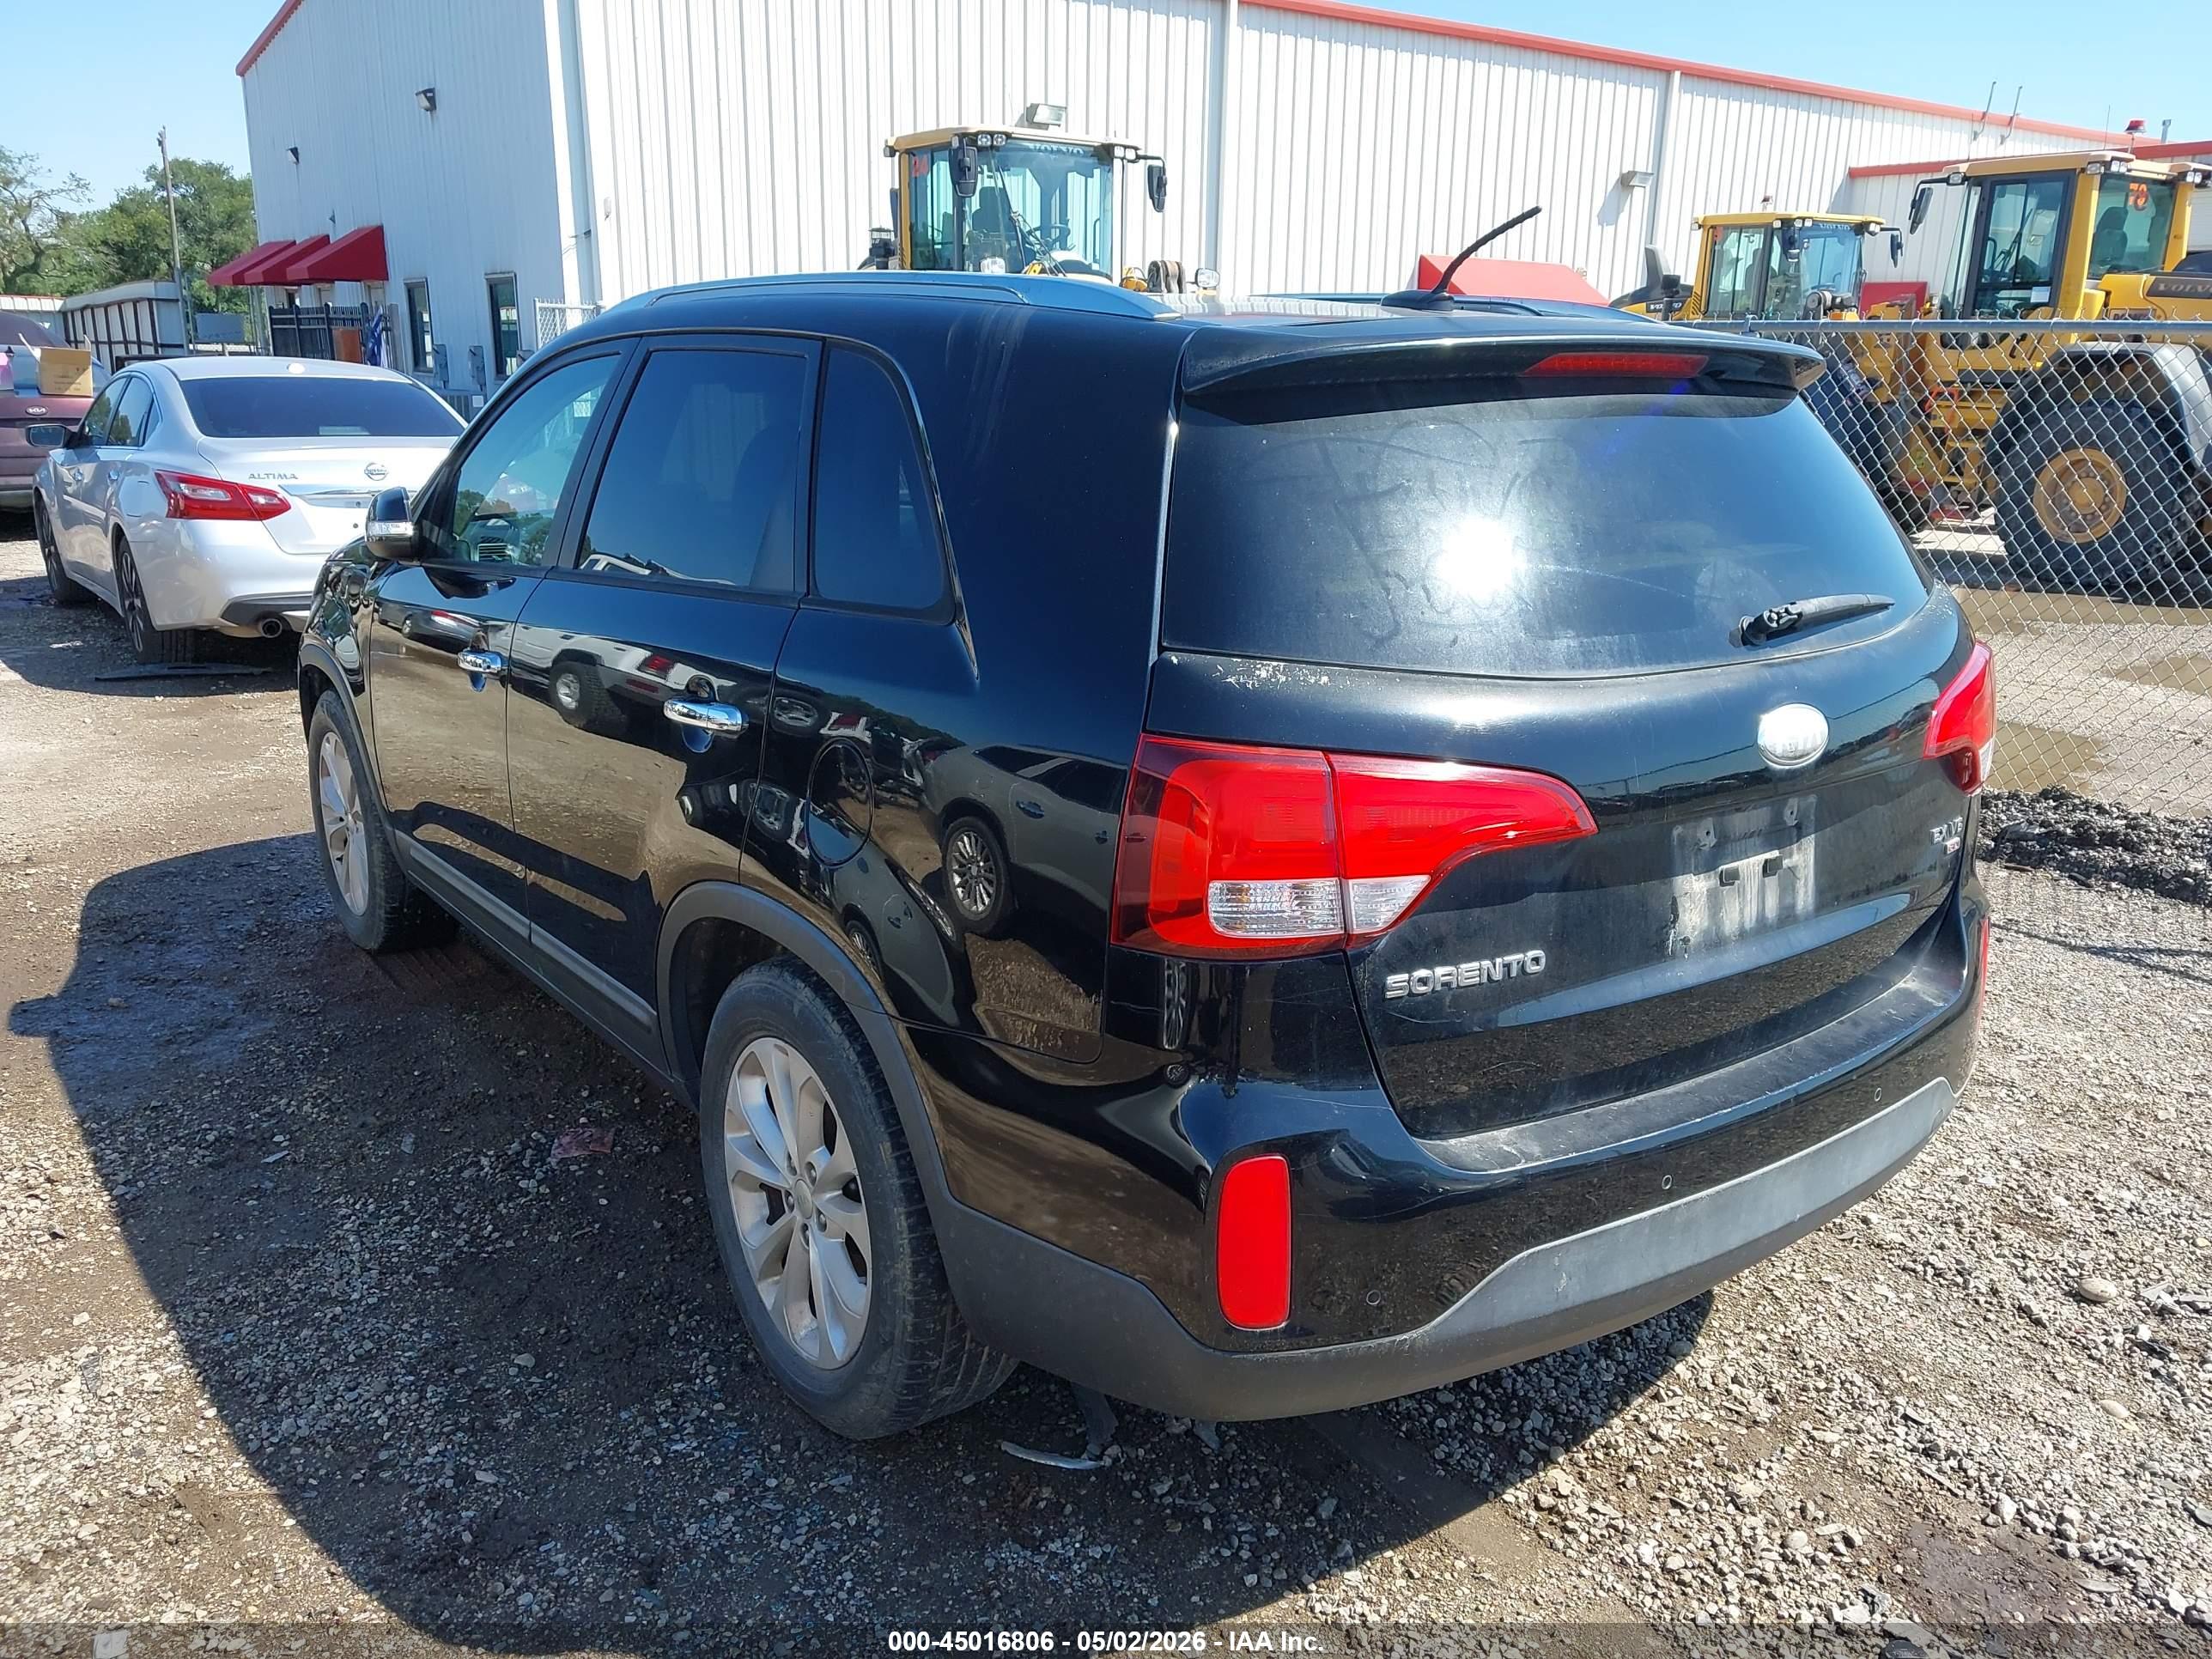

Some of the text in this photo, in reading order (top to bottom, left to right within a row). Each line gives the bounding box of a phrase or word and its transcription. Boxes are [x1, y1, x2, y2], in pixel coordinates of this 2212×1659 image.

[2158, 283, 2212, 294] VOLV
[1650, 301, 1682, 310] VOO
[1384, 949, 1547, 1000] SORENTO
